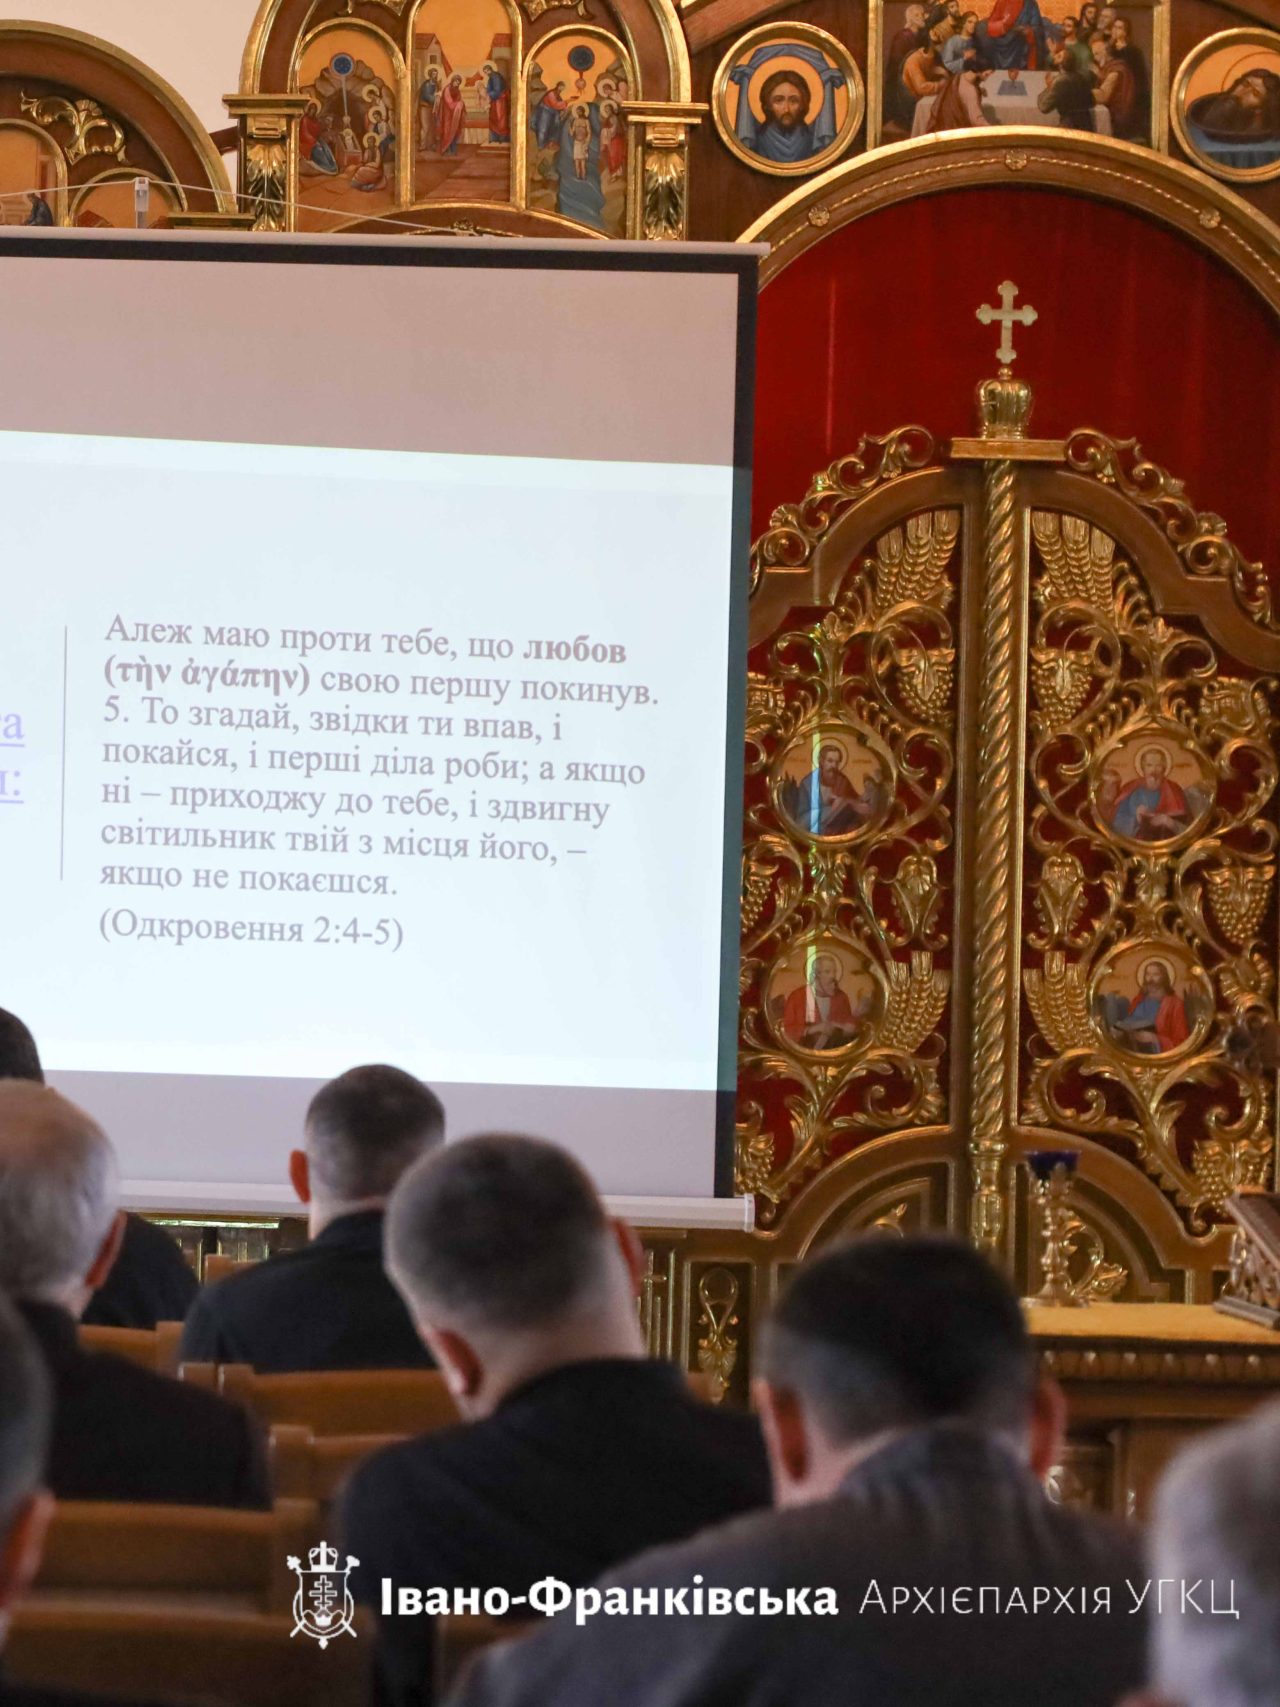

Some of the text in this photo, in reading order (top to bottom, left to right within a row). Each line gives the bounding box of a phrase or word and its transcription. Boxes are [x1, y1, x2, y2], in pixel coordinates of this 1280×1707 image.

[103, 613, 627, 665] Алеж маю проти тебе, що любов
[320, 670, 401, 693] свою
[409, 675, 512, 707] першу
[519, 679, 659, 711] покинув.
[103, 694, 562, 746] 5. То згадай, звідки ти впав, і
[101, 737, 646, 788] покайся, і перші діла роби; а якщо
[101, 775, 132, 804] ні
[169, 785, 328, 819] приходжу
[334, 792, 374, 817] до
[381, 787, 459, 822] тебе,
[469, 789, 479, 818] і
[487, 798, 611, 830] здвигну
[100, 816, 276, 851] світильник
[284, 823, 350, 854] твій
[358, 834, 374, 855] з
[382, 827, 470, 861] місця
[479, 831, 558, 868] його,
[99, 864, 398, 896] якщо не покаєшся.
[99, 907, 404, 953] (Одкровення 2:4-5)
